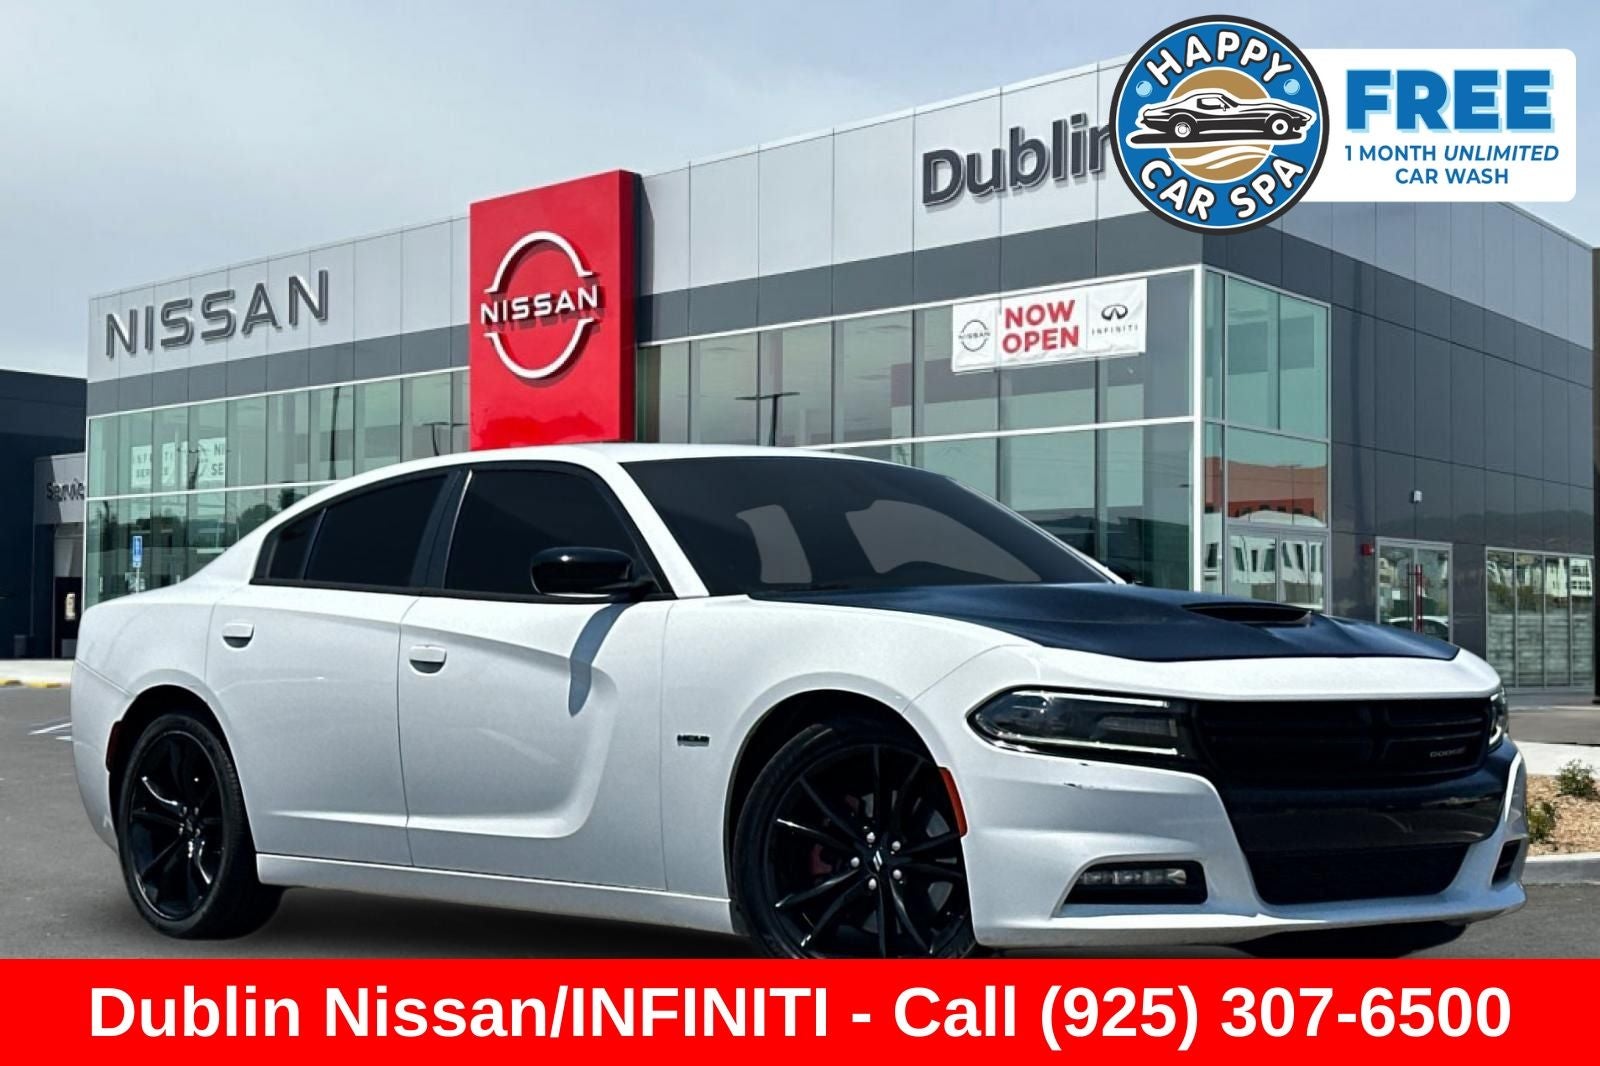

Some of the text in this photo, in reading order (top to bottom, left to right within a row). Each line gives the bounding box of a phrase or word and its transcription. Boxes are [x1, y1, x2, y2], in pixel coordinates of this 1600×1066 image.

[105, 269, 329, 358] NISSAN
[480, 285, 599, 326] NISSAN
[1005, 299, 1075, 329] NOW
[1002, 325, 1080, 354] OPEN
